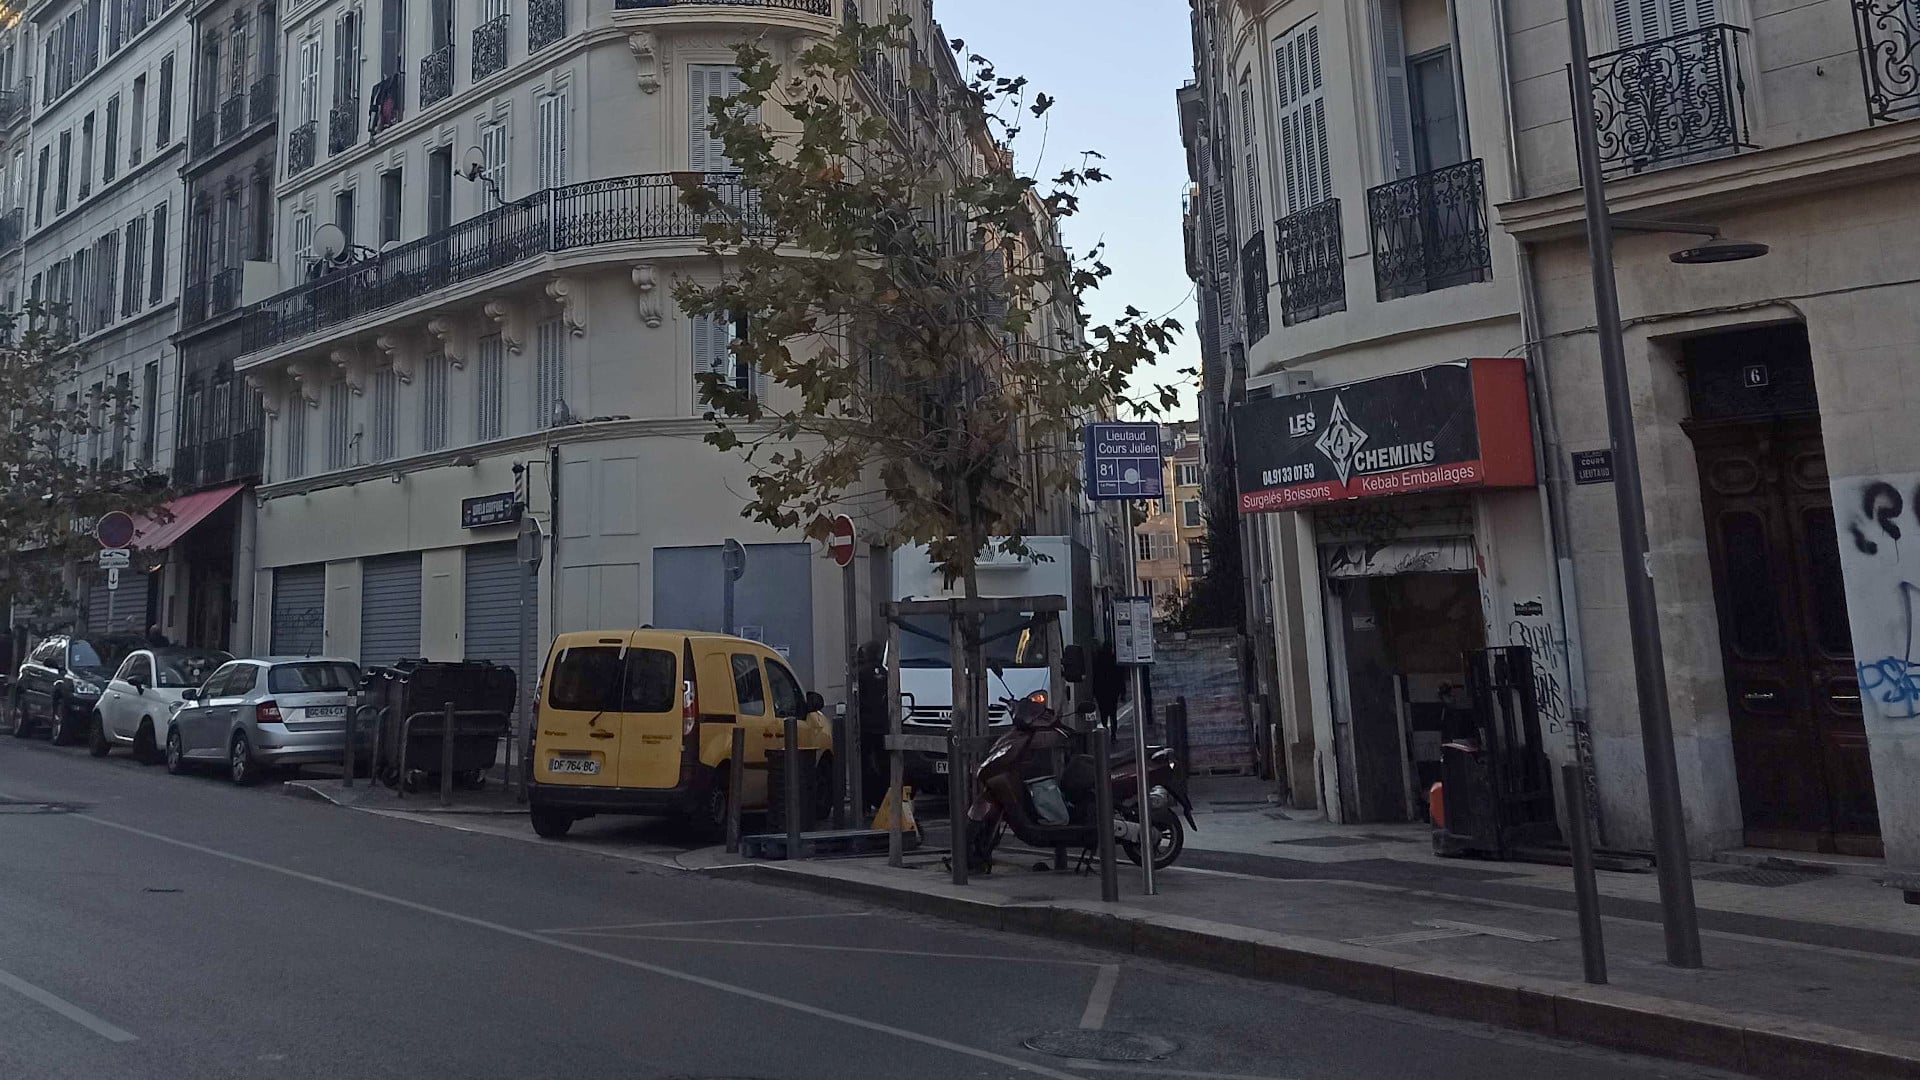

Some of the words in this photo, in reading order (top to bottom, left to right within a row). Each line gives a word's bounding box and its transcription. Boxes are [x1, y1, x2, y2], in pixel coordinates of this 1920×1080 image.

[1751, 368, 1760, 384] 6
[1289, 412, 1316, 434] LES
[1106, 430, 1146, 441] Lieutaud
[1098, 443, 1127, 454] Cours
[1129, 442, 1157, 454] Julien
[1354, 440, 1436, 471] CHEMINS
[1581, 457, 1605, 466] COURS
[1100, 464, 1114, 476] 81
[1579, 467, 1610, 480] LIEUTAUD
[1362, 475, 1399, 491] Kebab
[1402, 466, 1475, 486] Emballages
[1243, 490, 1282, 509] Surgelés
[1284, 486, 1331, 502] Boissons
